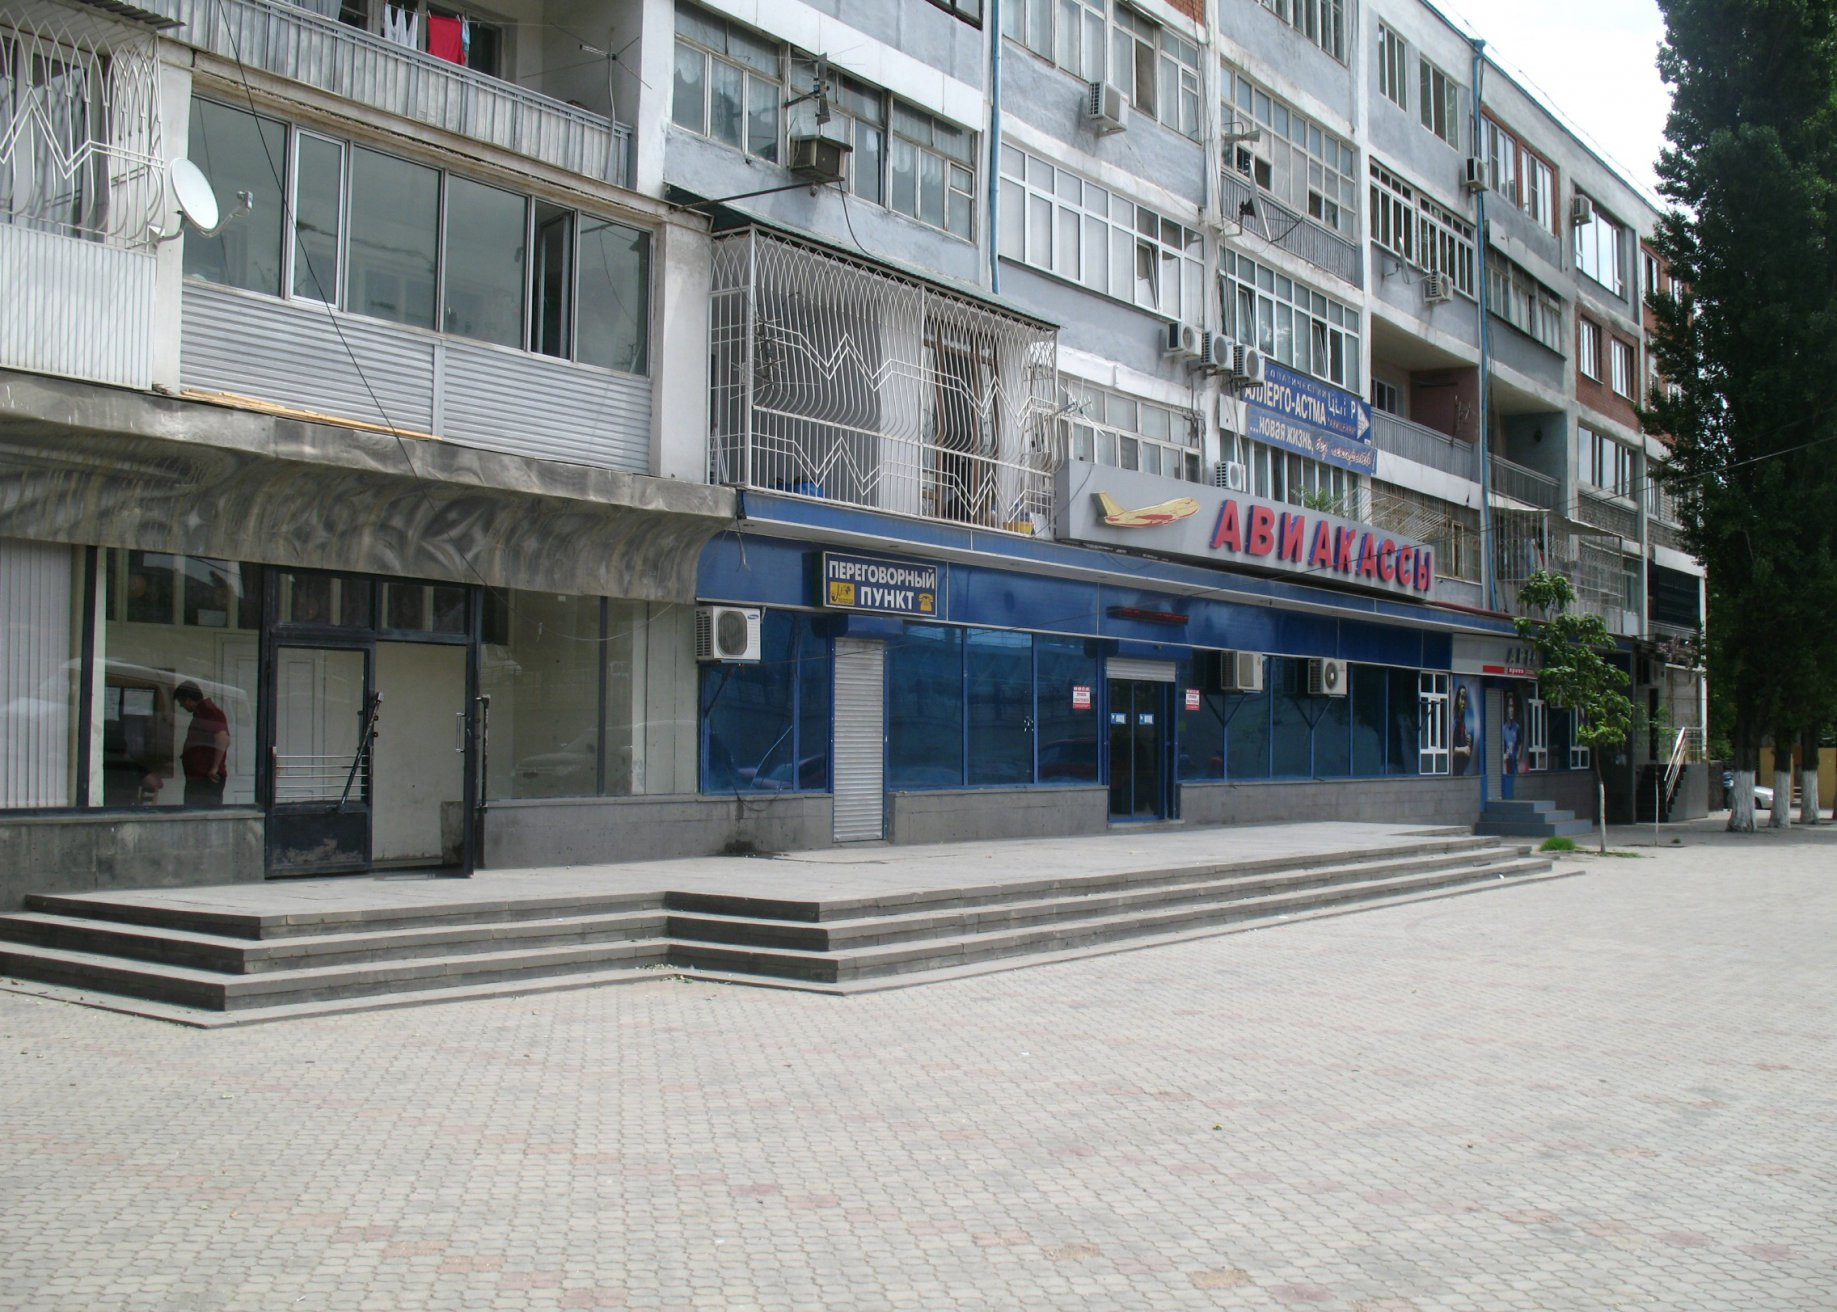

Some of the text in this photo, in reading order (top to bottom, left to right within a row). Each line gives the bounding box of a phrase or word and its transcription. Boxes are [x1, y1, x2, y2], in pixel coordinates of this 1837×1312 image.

[1245, 380, 1326, 426] АЛЛЕРГО-АСТМА
[1210, 499, 1431, 592] АВИАКАССЫ
[829, 560, 935, 590] ПЕРЕГОВОРНЫЙ
[861, 586, 915, 610] ПУНКТ
